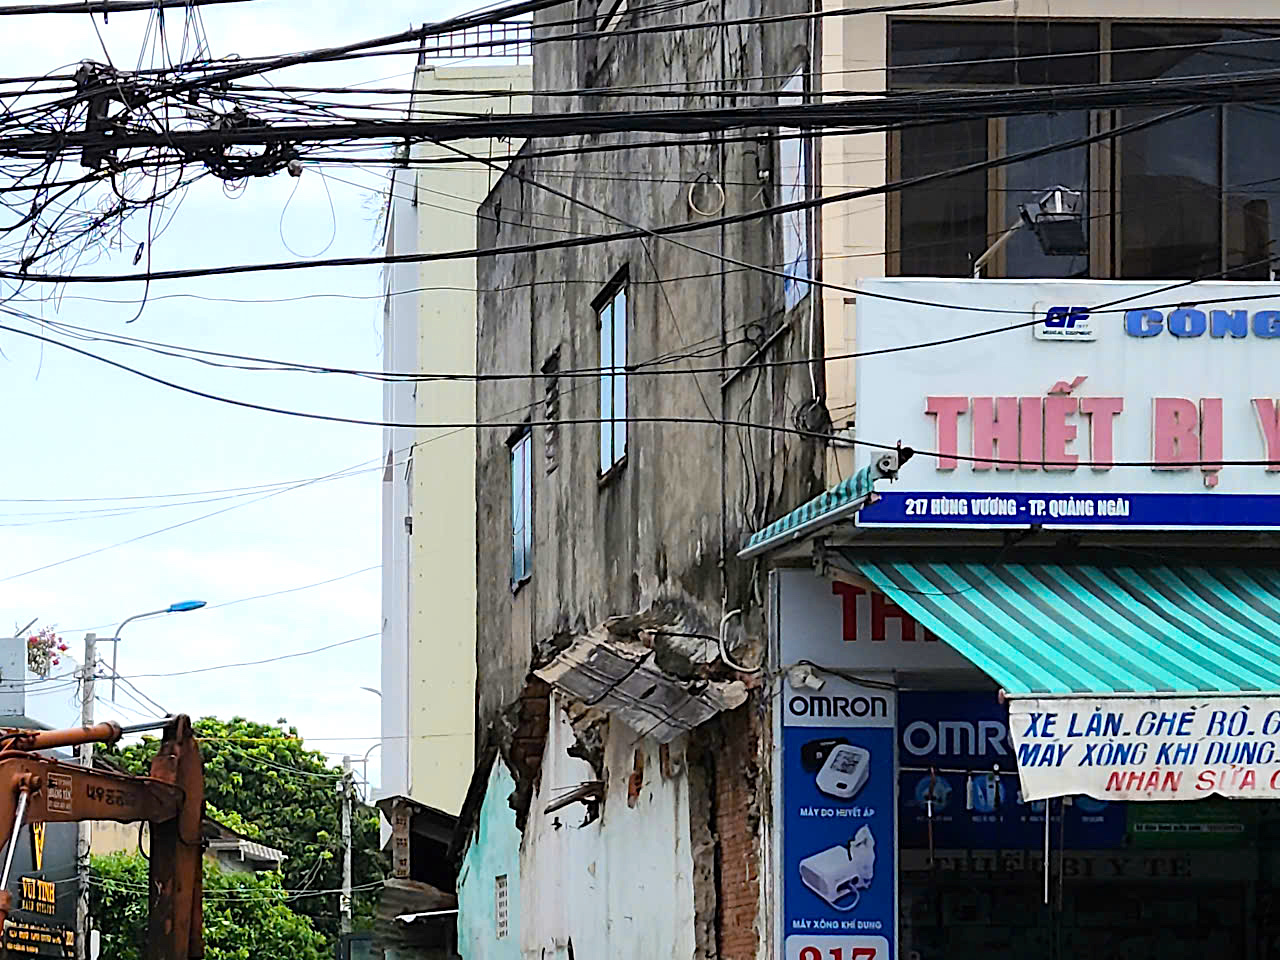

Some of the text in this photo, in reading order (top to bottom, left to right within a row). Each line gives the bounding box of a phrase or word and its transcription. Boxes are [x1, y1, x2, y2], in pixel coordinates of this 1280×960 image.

[924, 376, 1280, 488] THIẾT BỊ Y
[905, 498, 928, 515] 217
[930, 496, 969, 515] HÙNG
[970, 496, 1017, 516] VƯƠNG
[1028, 499, 1047, 516] TP.
[832, 581, 938, 641] TH
[789, 695, 887, 718] OMRON
[1022, 712, 1058, 737] XE
[903, 720, 1012, 756] OMR
[1018, 738, 1073, 767] MÁY
[1155, 737, 1206, 765] KHÍ
[1204, 741, 1276, 765] DUNG
[800, 806, 819, 816] MÁY
[863, 806, 875, 817] ÁP
[792, 918, 882, 929] MÁY XÔNG KHÍ DUNG
